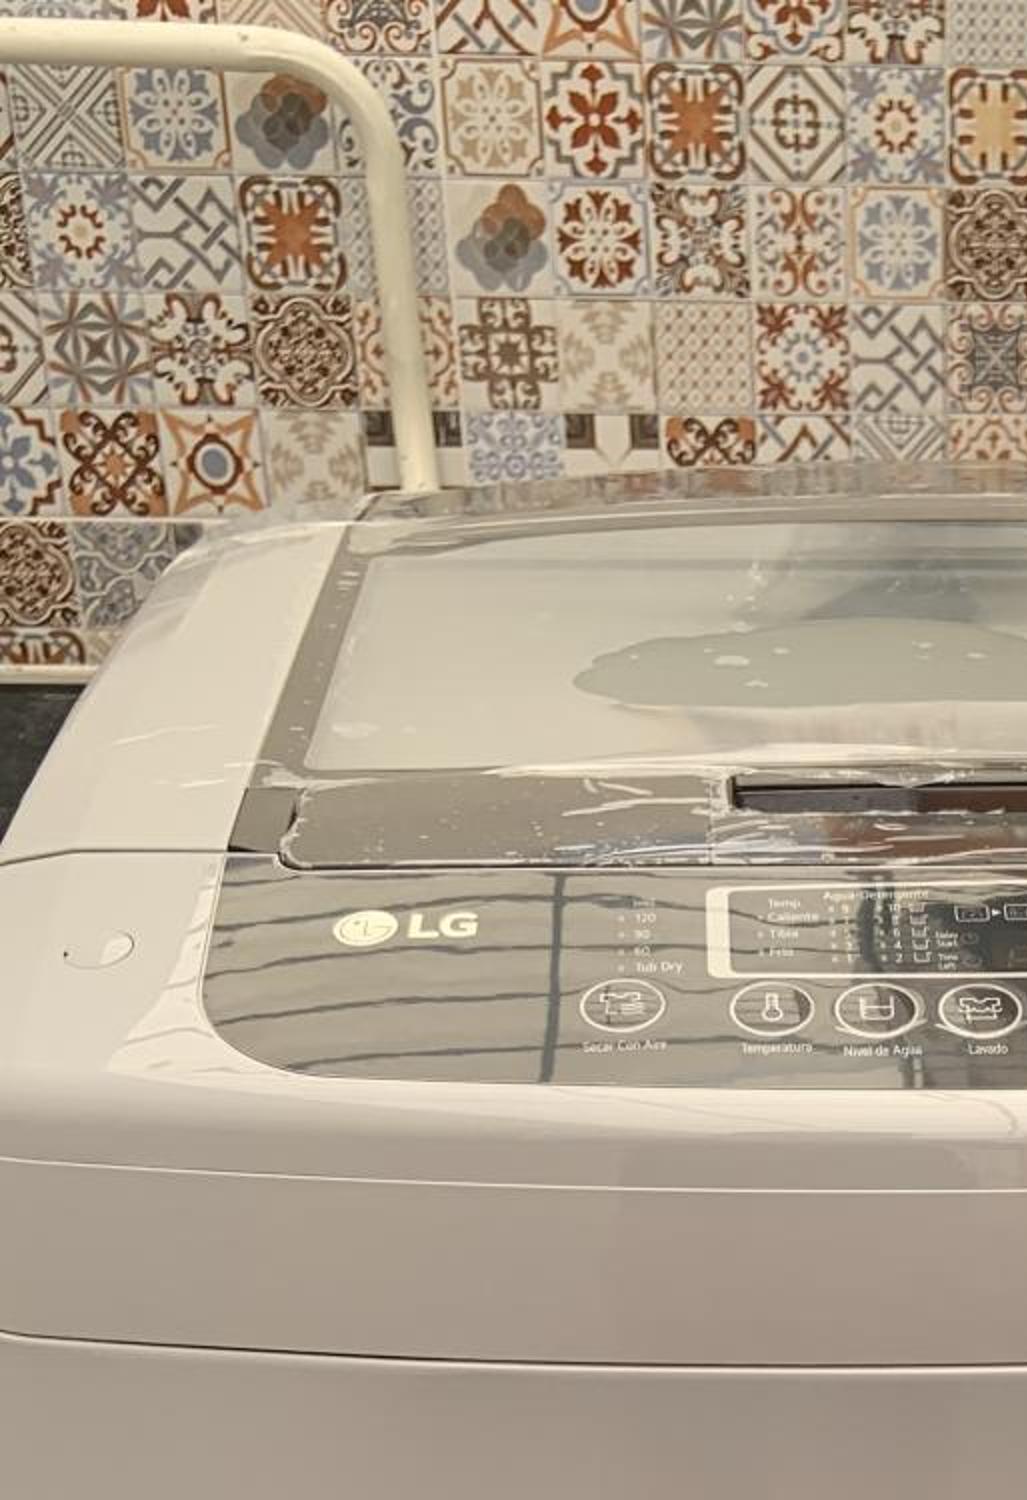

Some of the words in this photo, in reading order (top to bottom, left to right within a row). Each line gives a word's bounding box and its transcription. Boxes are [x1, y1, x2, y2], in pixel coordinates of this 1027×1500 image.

[635, 912, 656, 923] 120
[767, 912, 819, 922] Caliente
[407, 911, 479, 938] LG
[660, 961, 683, 975] Dry
[741, 1043, 813, 1056] Temperatura
[843, 1046, 872, 1056] Nivel
[875, 1045, 889, 1056] de
[892, 1045, 924, 1058] Agua
[967, 1043, 1010, 1055] Lavado
